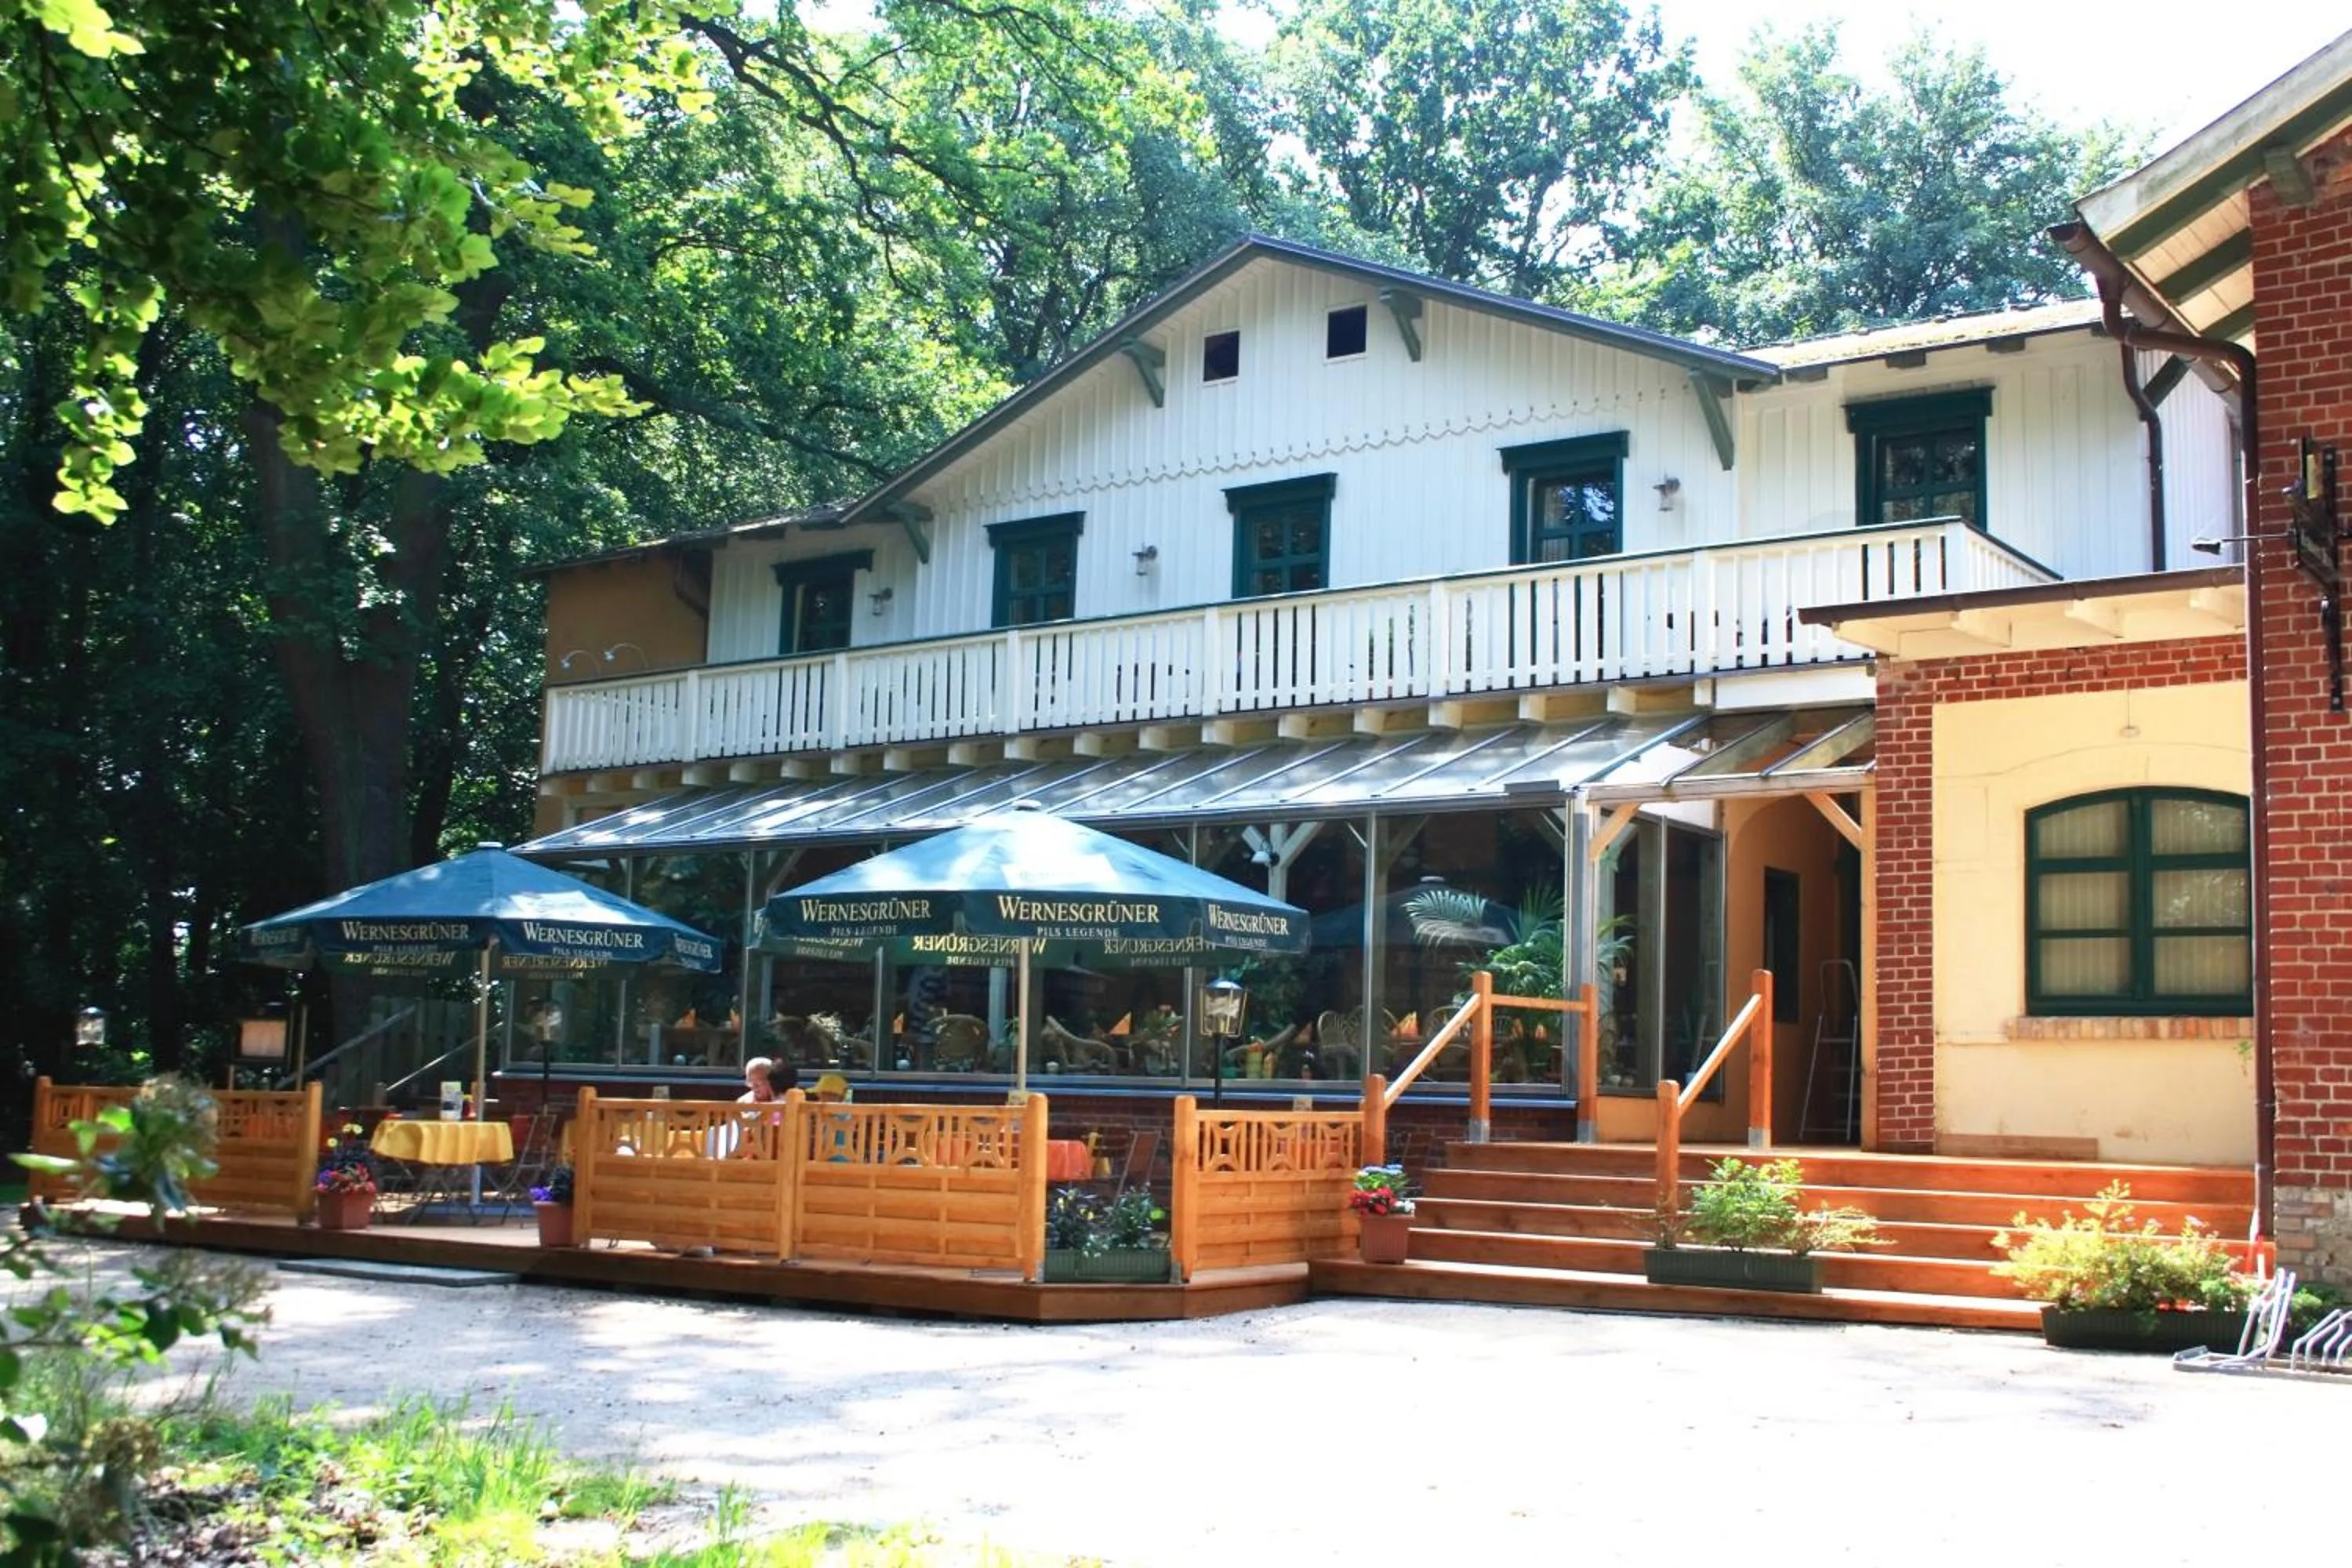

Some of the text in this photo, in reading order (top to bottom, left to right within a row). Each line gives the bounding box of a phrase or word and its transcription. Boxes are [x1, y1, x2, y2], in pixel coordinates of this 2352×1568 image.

[800, 897, 931, 923] WERNESGRÜNER
[997, 895, 1160, 923] WERNESGRÜNER
[1207, 904, 1290, 935] WERNESGRÜNER
[342, 920, 469, 940] WERNESGRÜNER
[523, 921, 644, 949] WERNESGRÜNER
[1037, 926, 1120, 938] PILS LEGENDE
